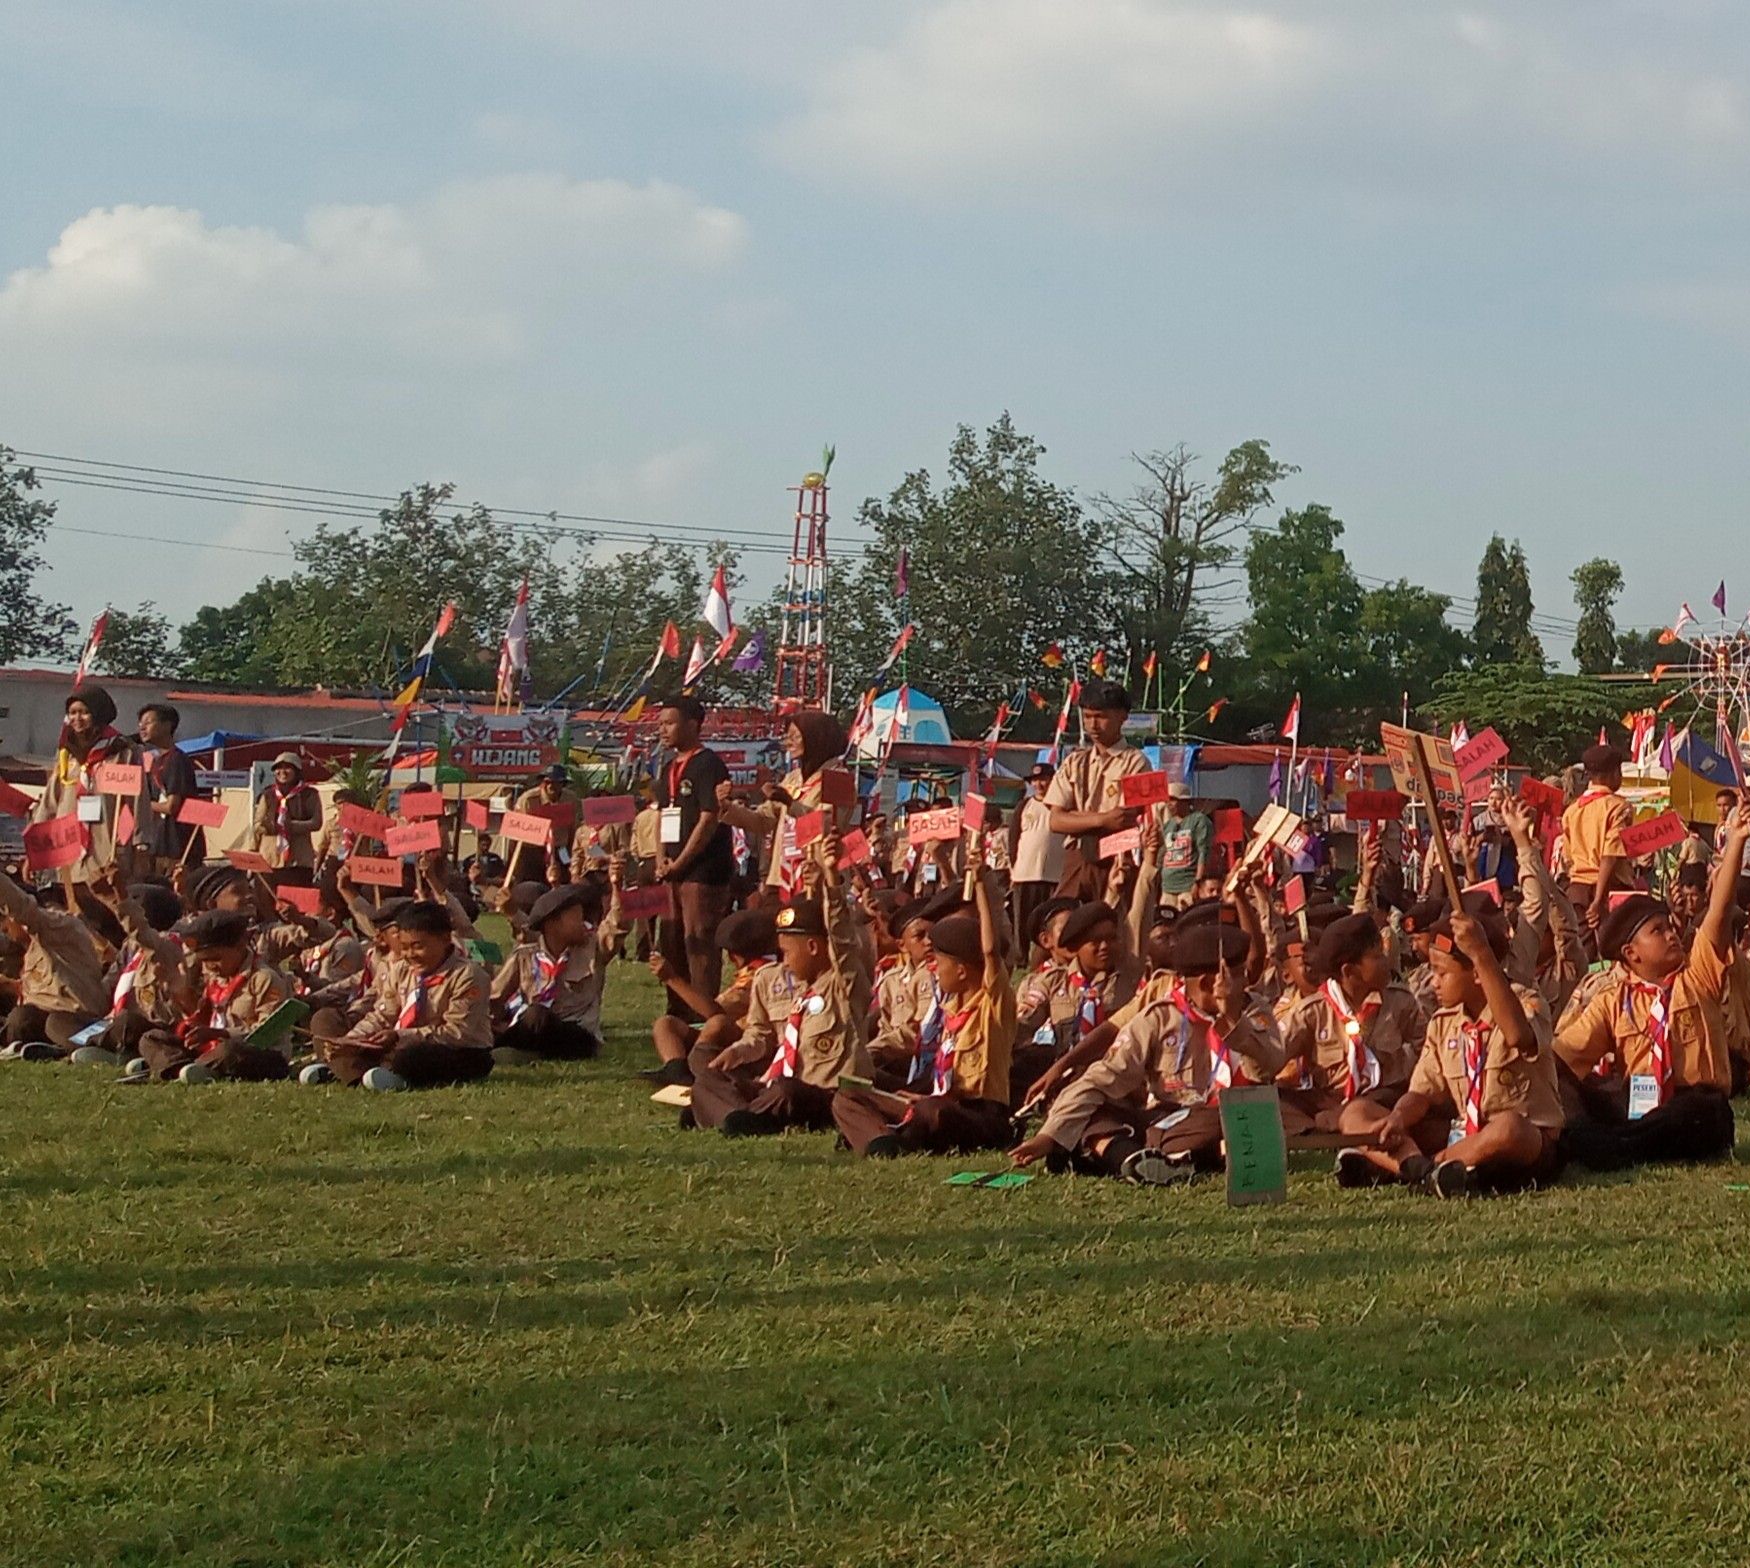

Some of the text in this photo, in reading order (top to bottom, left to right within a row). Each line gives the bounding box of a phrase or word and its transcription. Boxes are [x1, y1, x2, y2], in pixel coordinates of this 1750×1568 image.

[105, 771, 136, 782] SALAH
[509, 818, 542, 833] SALAH
[1630, 822, 1674, 845] SALAH
[358, 865, 394, 875] SALAH
